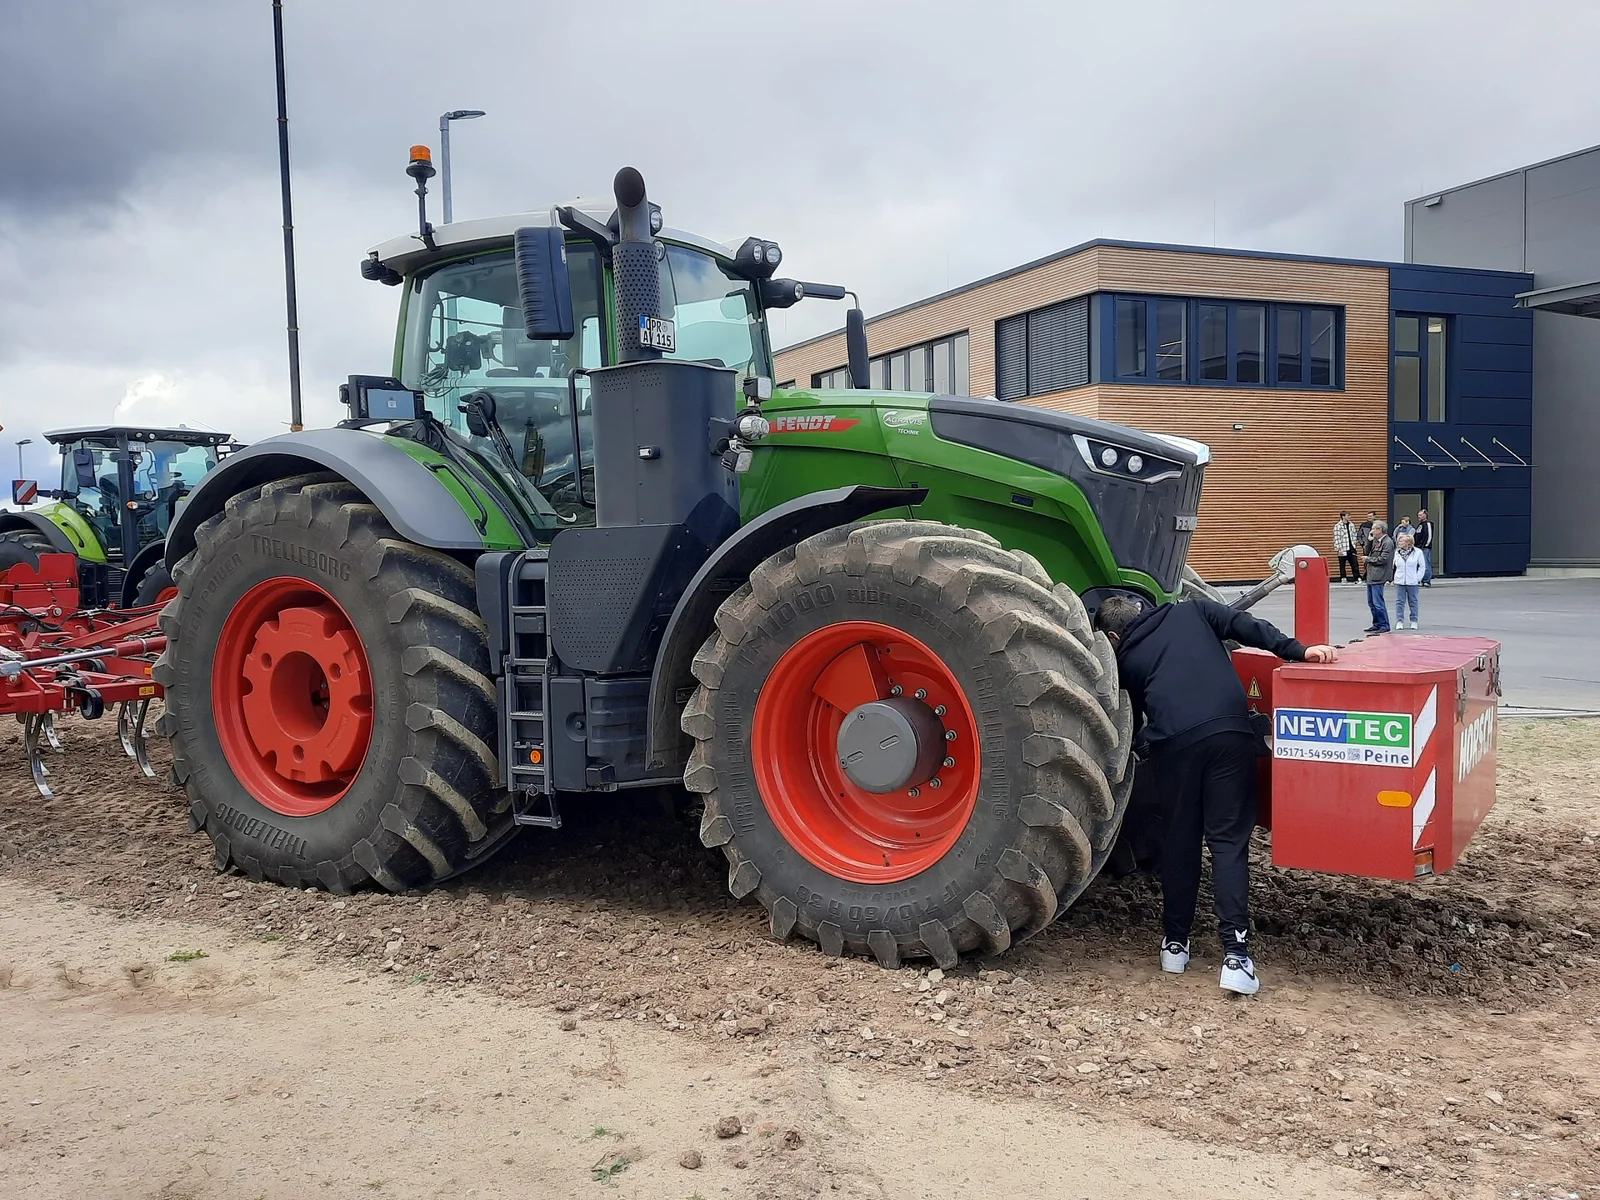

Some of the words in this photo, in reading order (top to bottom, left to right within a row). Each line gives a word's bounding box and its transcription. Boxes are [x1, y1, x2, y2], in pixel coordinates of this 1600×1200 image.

[656, 333, 671, 347] 115
[776, 415, 836, 431] FENDT
[886, 415, 923, 426] AGRAVIS
[251, 534, 350, 581] TRELLEBORG
[737, 583, 836, 668] TM1000
[1279, 714, 1403, 742] NEWTEC
[1276, 746, 1346, 761] 05171-545950
[1364, 749, 1410, 765] Peine
[1458, 705, 1494, 784] HORSCH
[214, 803, 307, 861] TRELLEBORG
[795, 884, 823, 909] 38
[827, 898, 843, 919] R
[848, 895, 938, 924] 710/60
